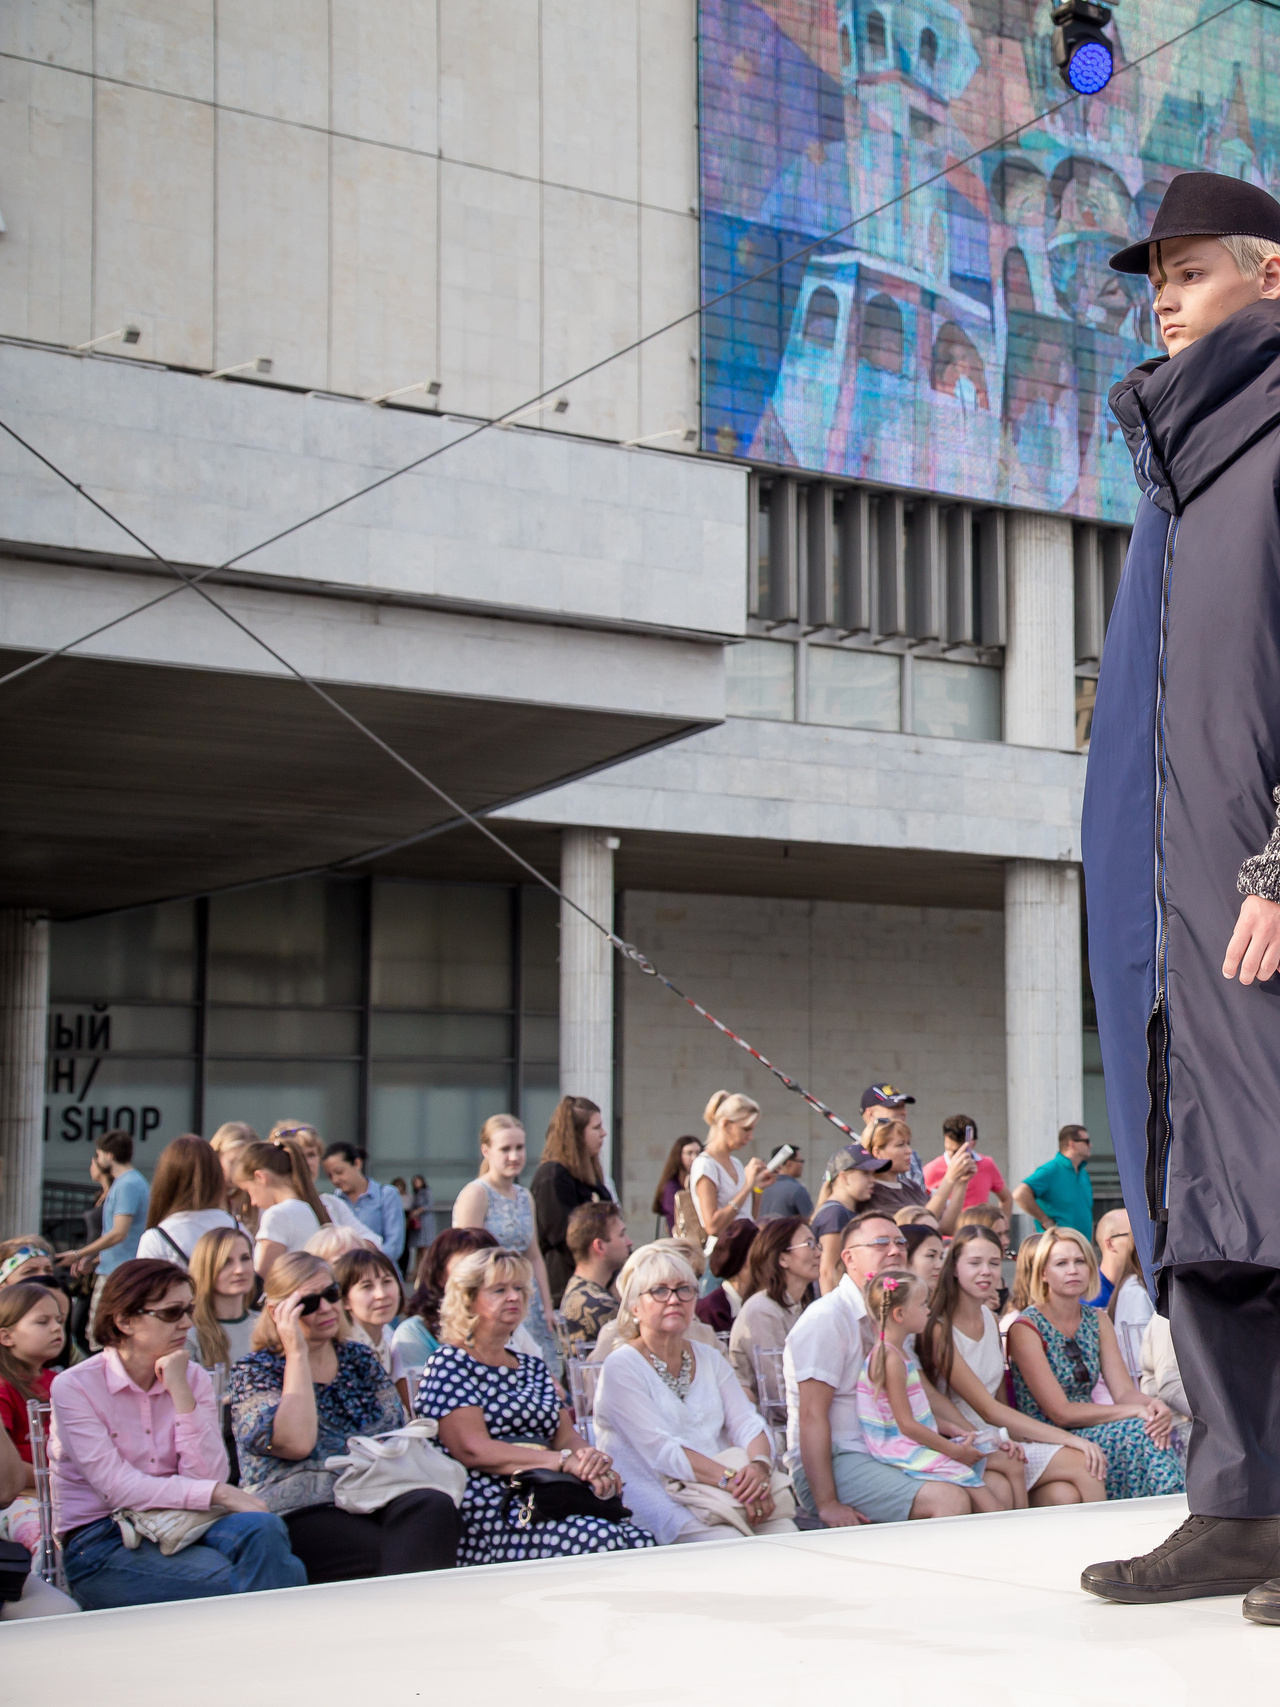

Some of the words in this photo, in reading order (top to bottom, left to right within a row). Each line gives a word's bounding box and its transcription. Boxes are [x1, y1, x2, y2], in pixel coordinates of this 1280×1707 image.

[48, 1002, 111, 1051] ЫЙ
[47, 1057, 102, 1103] Н/
[60, 1105, 161, 1142] SHOP
